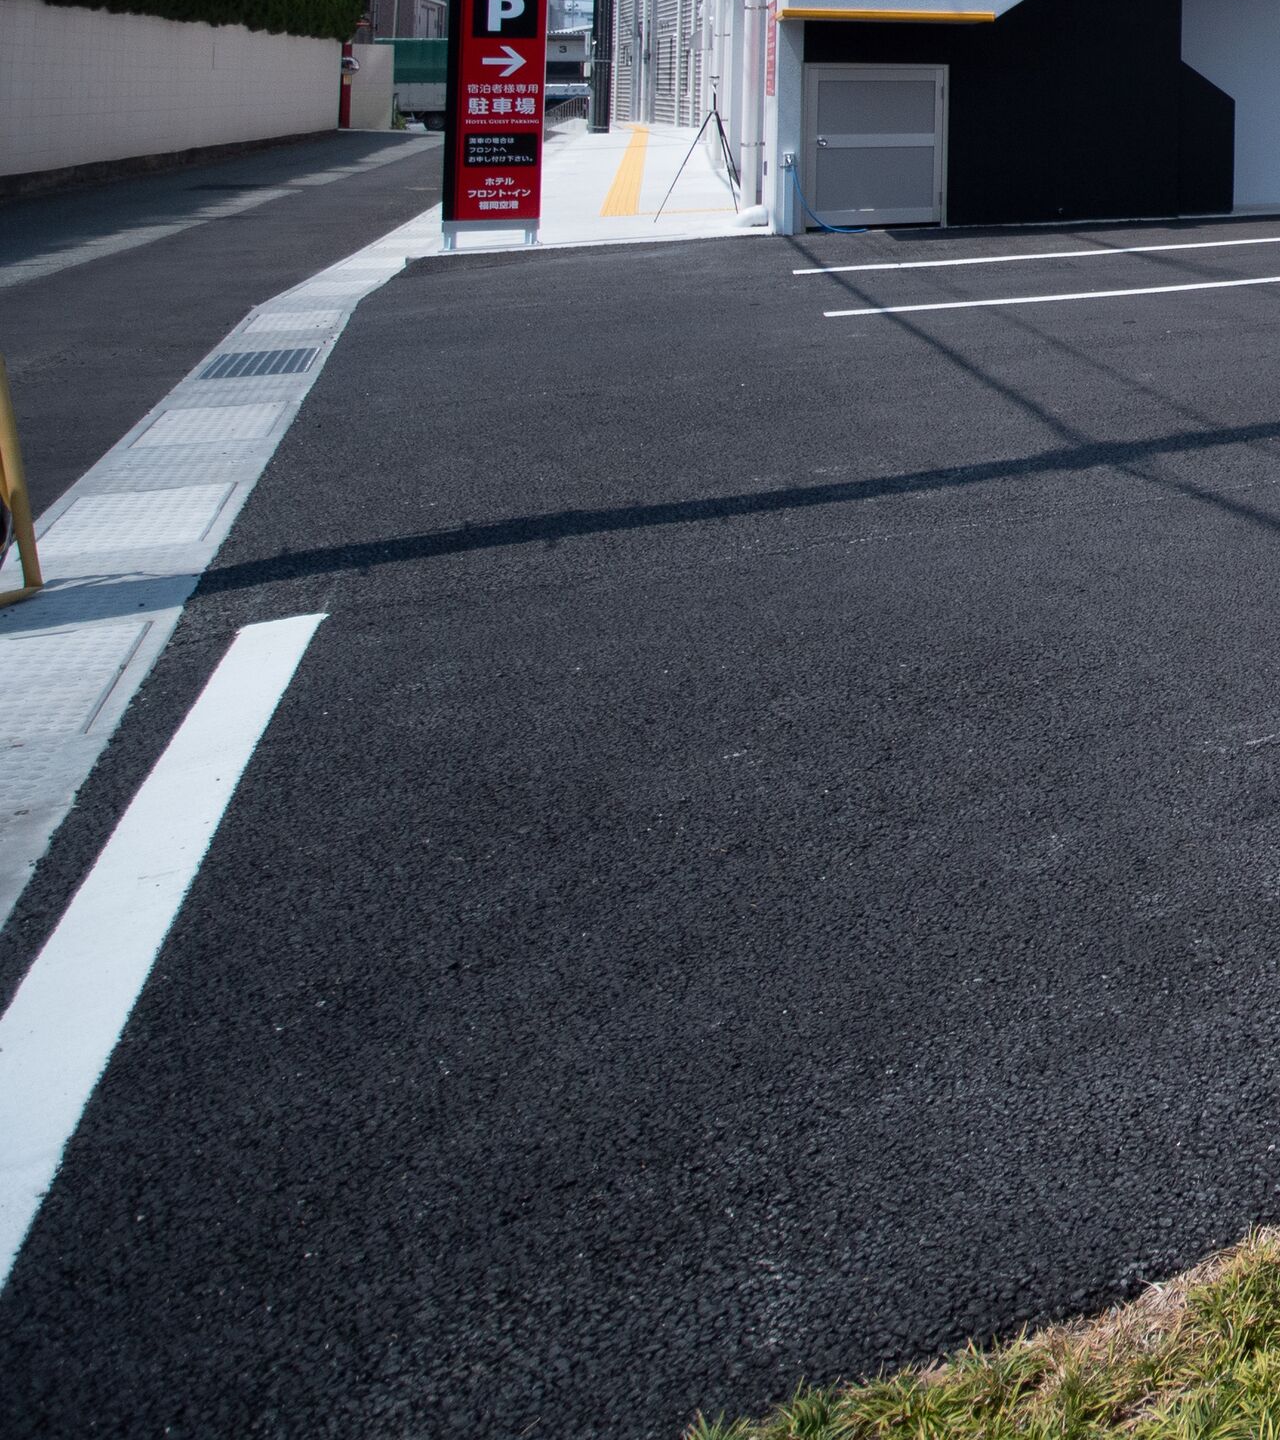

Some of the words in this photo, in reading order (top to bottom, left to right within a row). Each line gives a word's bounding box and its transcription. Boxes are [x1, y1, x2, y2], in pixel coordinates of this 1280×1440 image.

[467, 83, 539, 94] 宿泊者様専用
[468, 97, 536, 115] 駐車場
[468, 146, 507, 154] フロントへ
[485, 177, 515, 186] ホテル
[467, 188, 531, 199] フロント・イン
